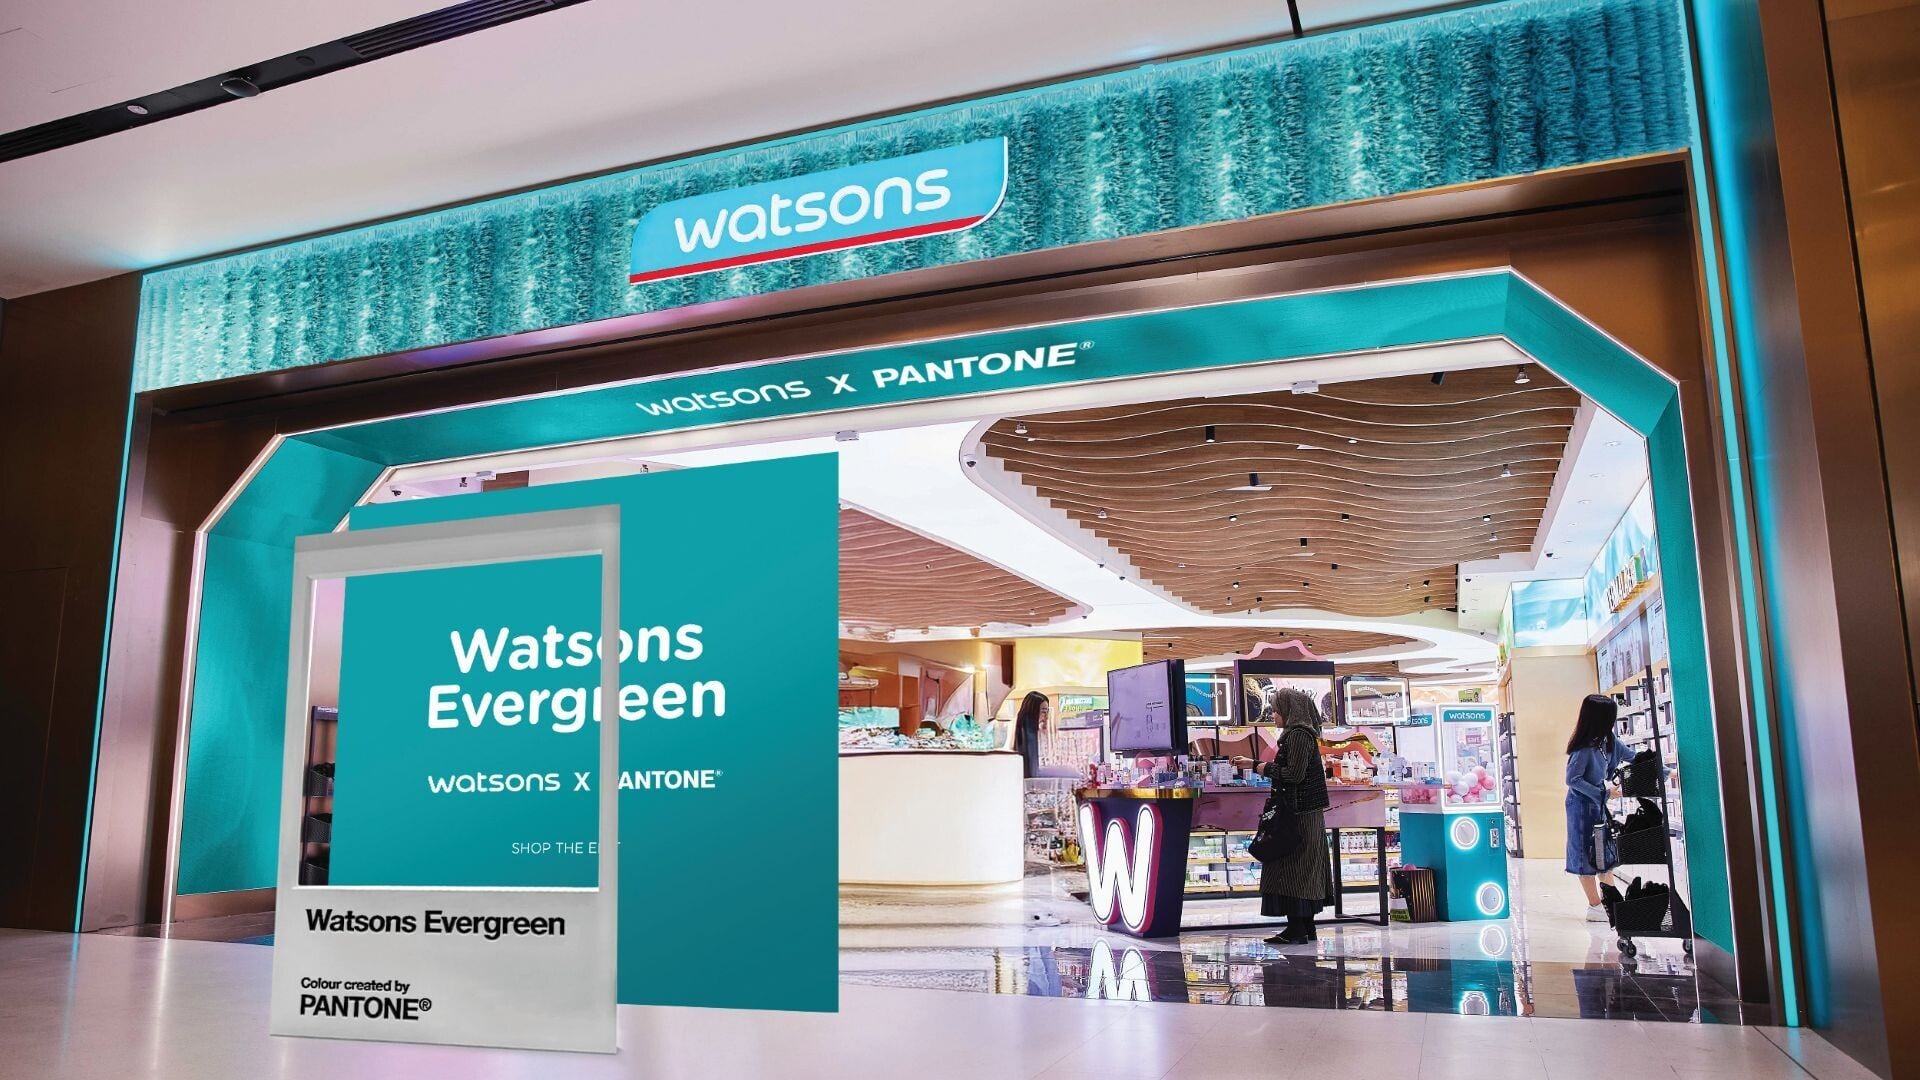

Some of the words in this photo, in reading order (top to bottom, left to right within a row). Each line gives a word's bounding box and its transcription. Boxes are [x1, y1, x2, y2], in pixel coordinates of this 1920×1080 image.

[674, 168, 951, 253] watsons
[636, 379, 811, 417] watsons
[825, 373, 857, 395] X
[450, 623, 704, 673] Watsons
[1448, 712, 1486, 720] watsons
[427, 772, 561, 794] watsons
[573, 772, 591, 792] X
[618, 769, 723, 790] ANTONE®
[511, 842, 551, 855] SHOP
[555, 842, 584, 854] THE
[1080, 804, 1156, 932] W
[305, 908, 417, 934] Watsons
[424, 910, 565, 941] Evergreen
[300, 976, 342, 991] Colour
[343, 978, 392, 992] created
[394, 979, 410, 994] by
